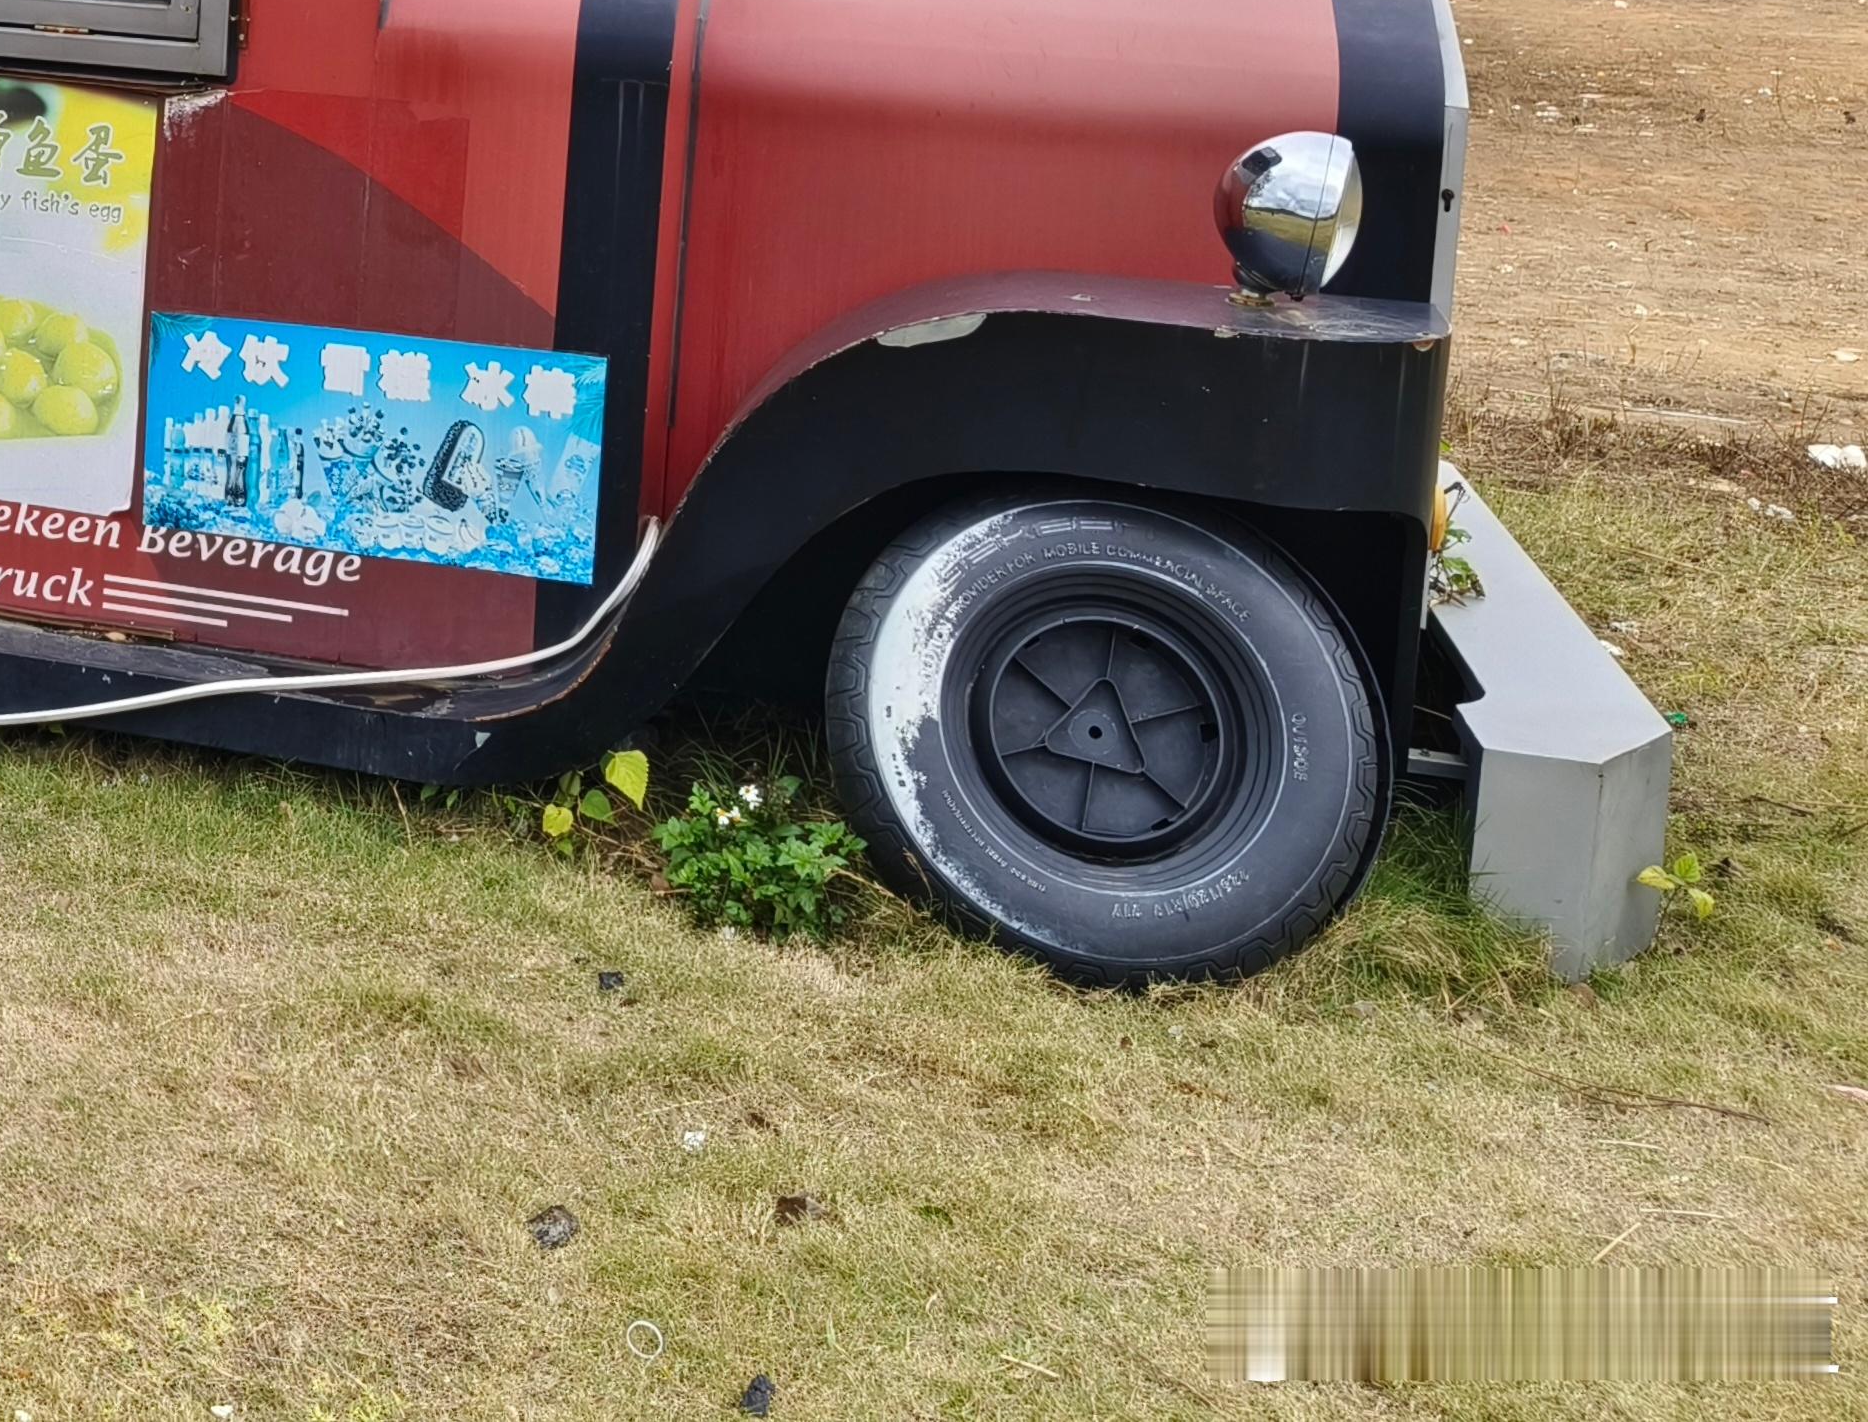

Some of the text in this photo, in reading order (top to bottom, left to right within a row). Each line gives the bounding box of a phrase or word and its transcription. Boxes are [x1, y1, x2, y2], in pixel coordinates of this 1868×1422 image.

[21, 189, 80, 216] fish's
[89, 202, 122, 224] egg
[136, 525, 363, 586] Beverage
[1043, 541, 1102, 559] MOBILE
